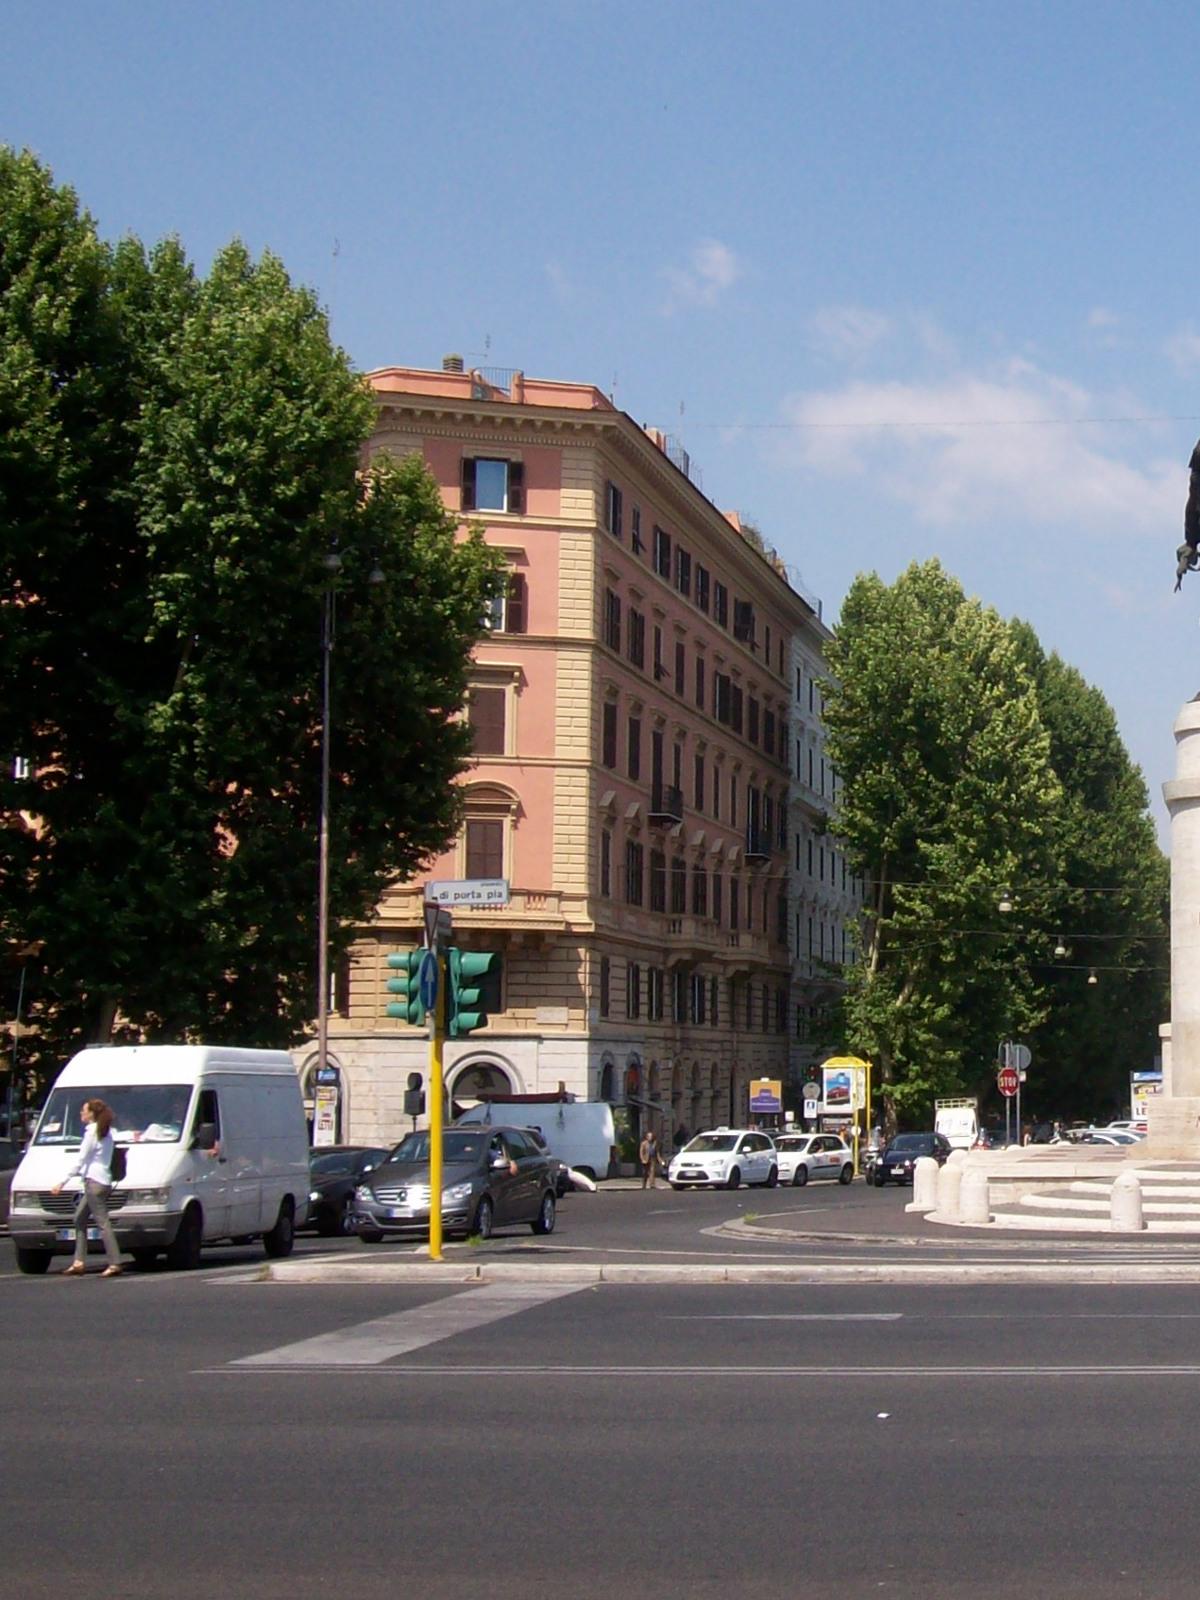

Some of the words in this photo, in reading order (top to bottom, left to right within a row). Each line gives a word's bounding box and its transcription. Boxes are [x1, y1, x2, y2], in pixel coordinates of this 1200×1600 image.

[439, 890, 449, 899] di
[453, 891, 482, 901] porta
[487, 890, 503, 899] pia
[1000, 1076, 1017, 1087] STOP
